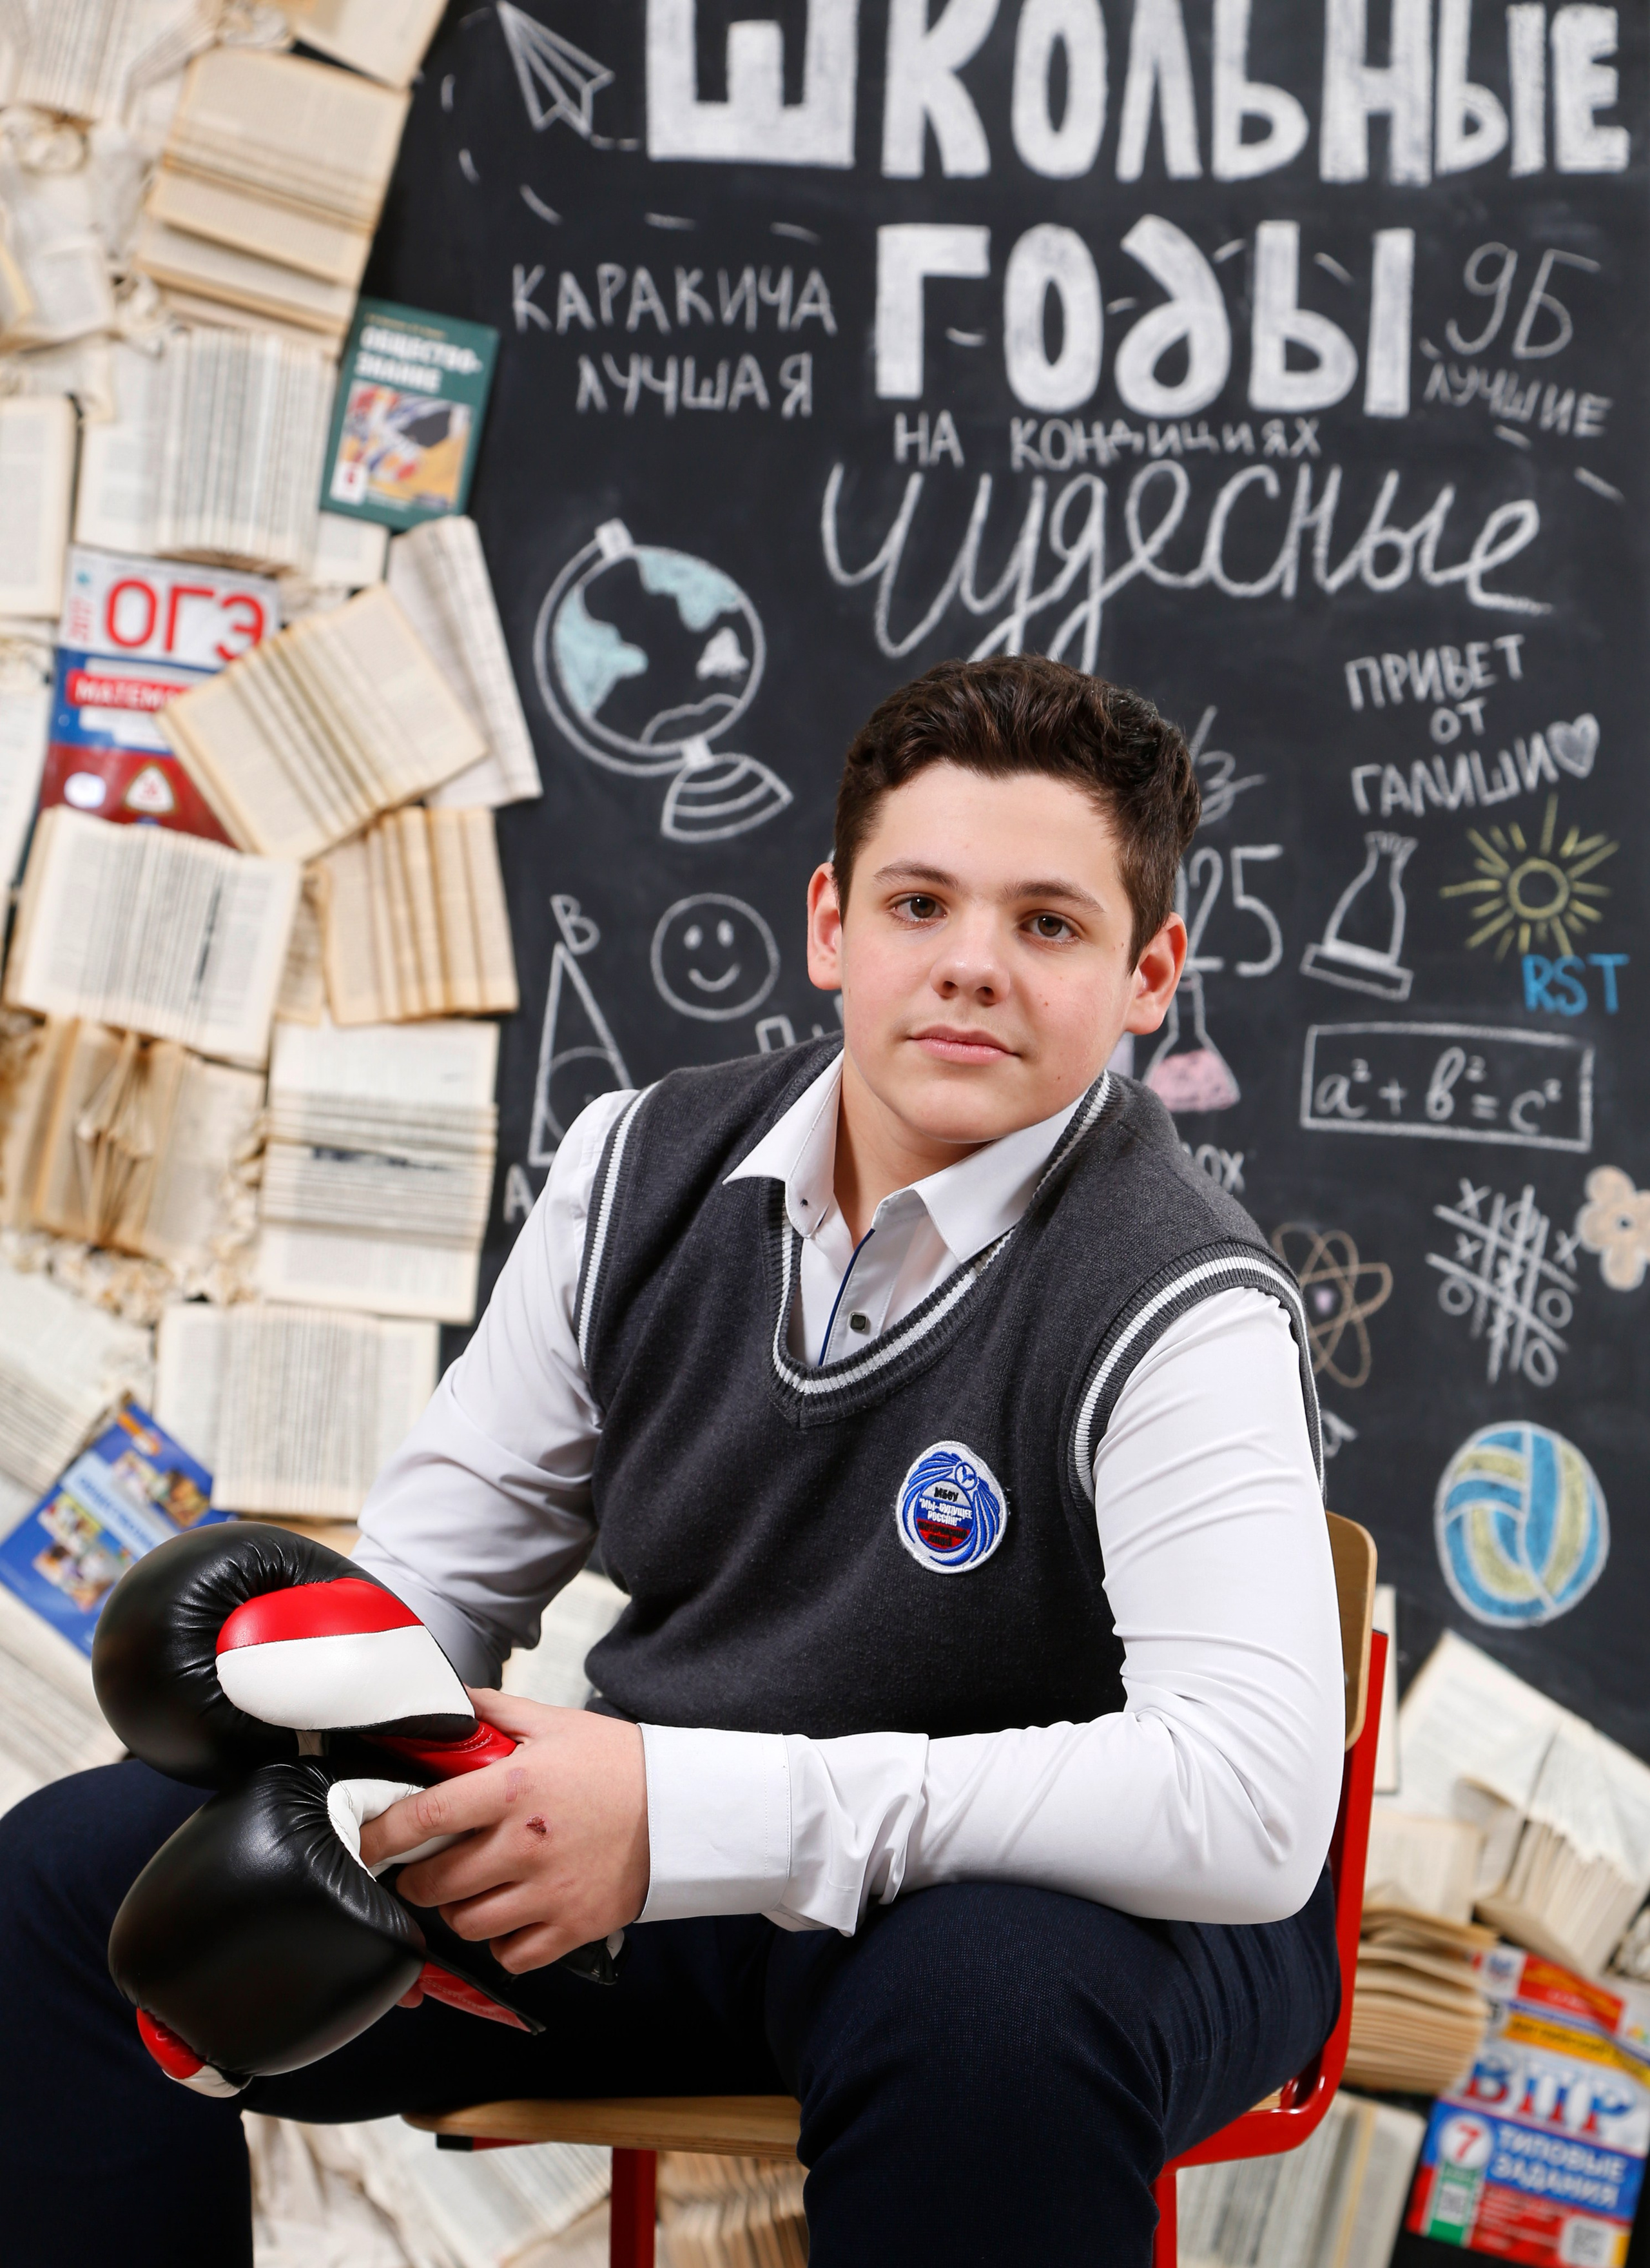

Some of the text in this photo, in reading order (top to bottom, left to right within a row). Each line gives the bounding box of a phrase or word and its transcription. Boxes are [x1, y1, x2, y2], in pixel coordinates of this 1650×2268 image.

[646, 0, 1631, 187] ШКОЛЬНЫЕ
[512, 262, 837, 335] КАРАКИЧА
[576, 351, 813, 419] ЛУЧШАЯ
[1422, 361, 1612, 438] ЛУЧШИЕ
[893, 410, 965, 467] НА
[104, 576, 267, 662] ОГЭ
[1344, 632, 1526, 711] ПРИВЕТ
[1522, 952, 1631, 1017] RST
[1455, 2122, 1482, 2160] 7
[1497, 2126, 1627, 2184] ТИПОВЫЕ
[1492, 2155, 1621, 2209] ЗАДАНИЯ
